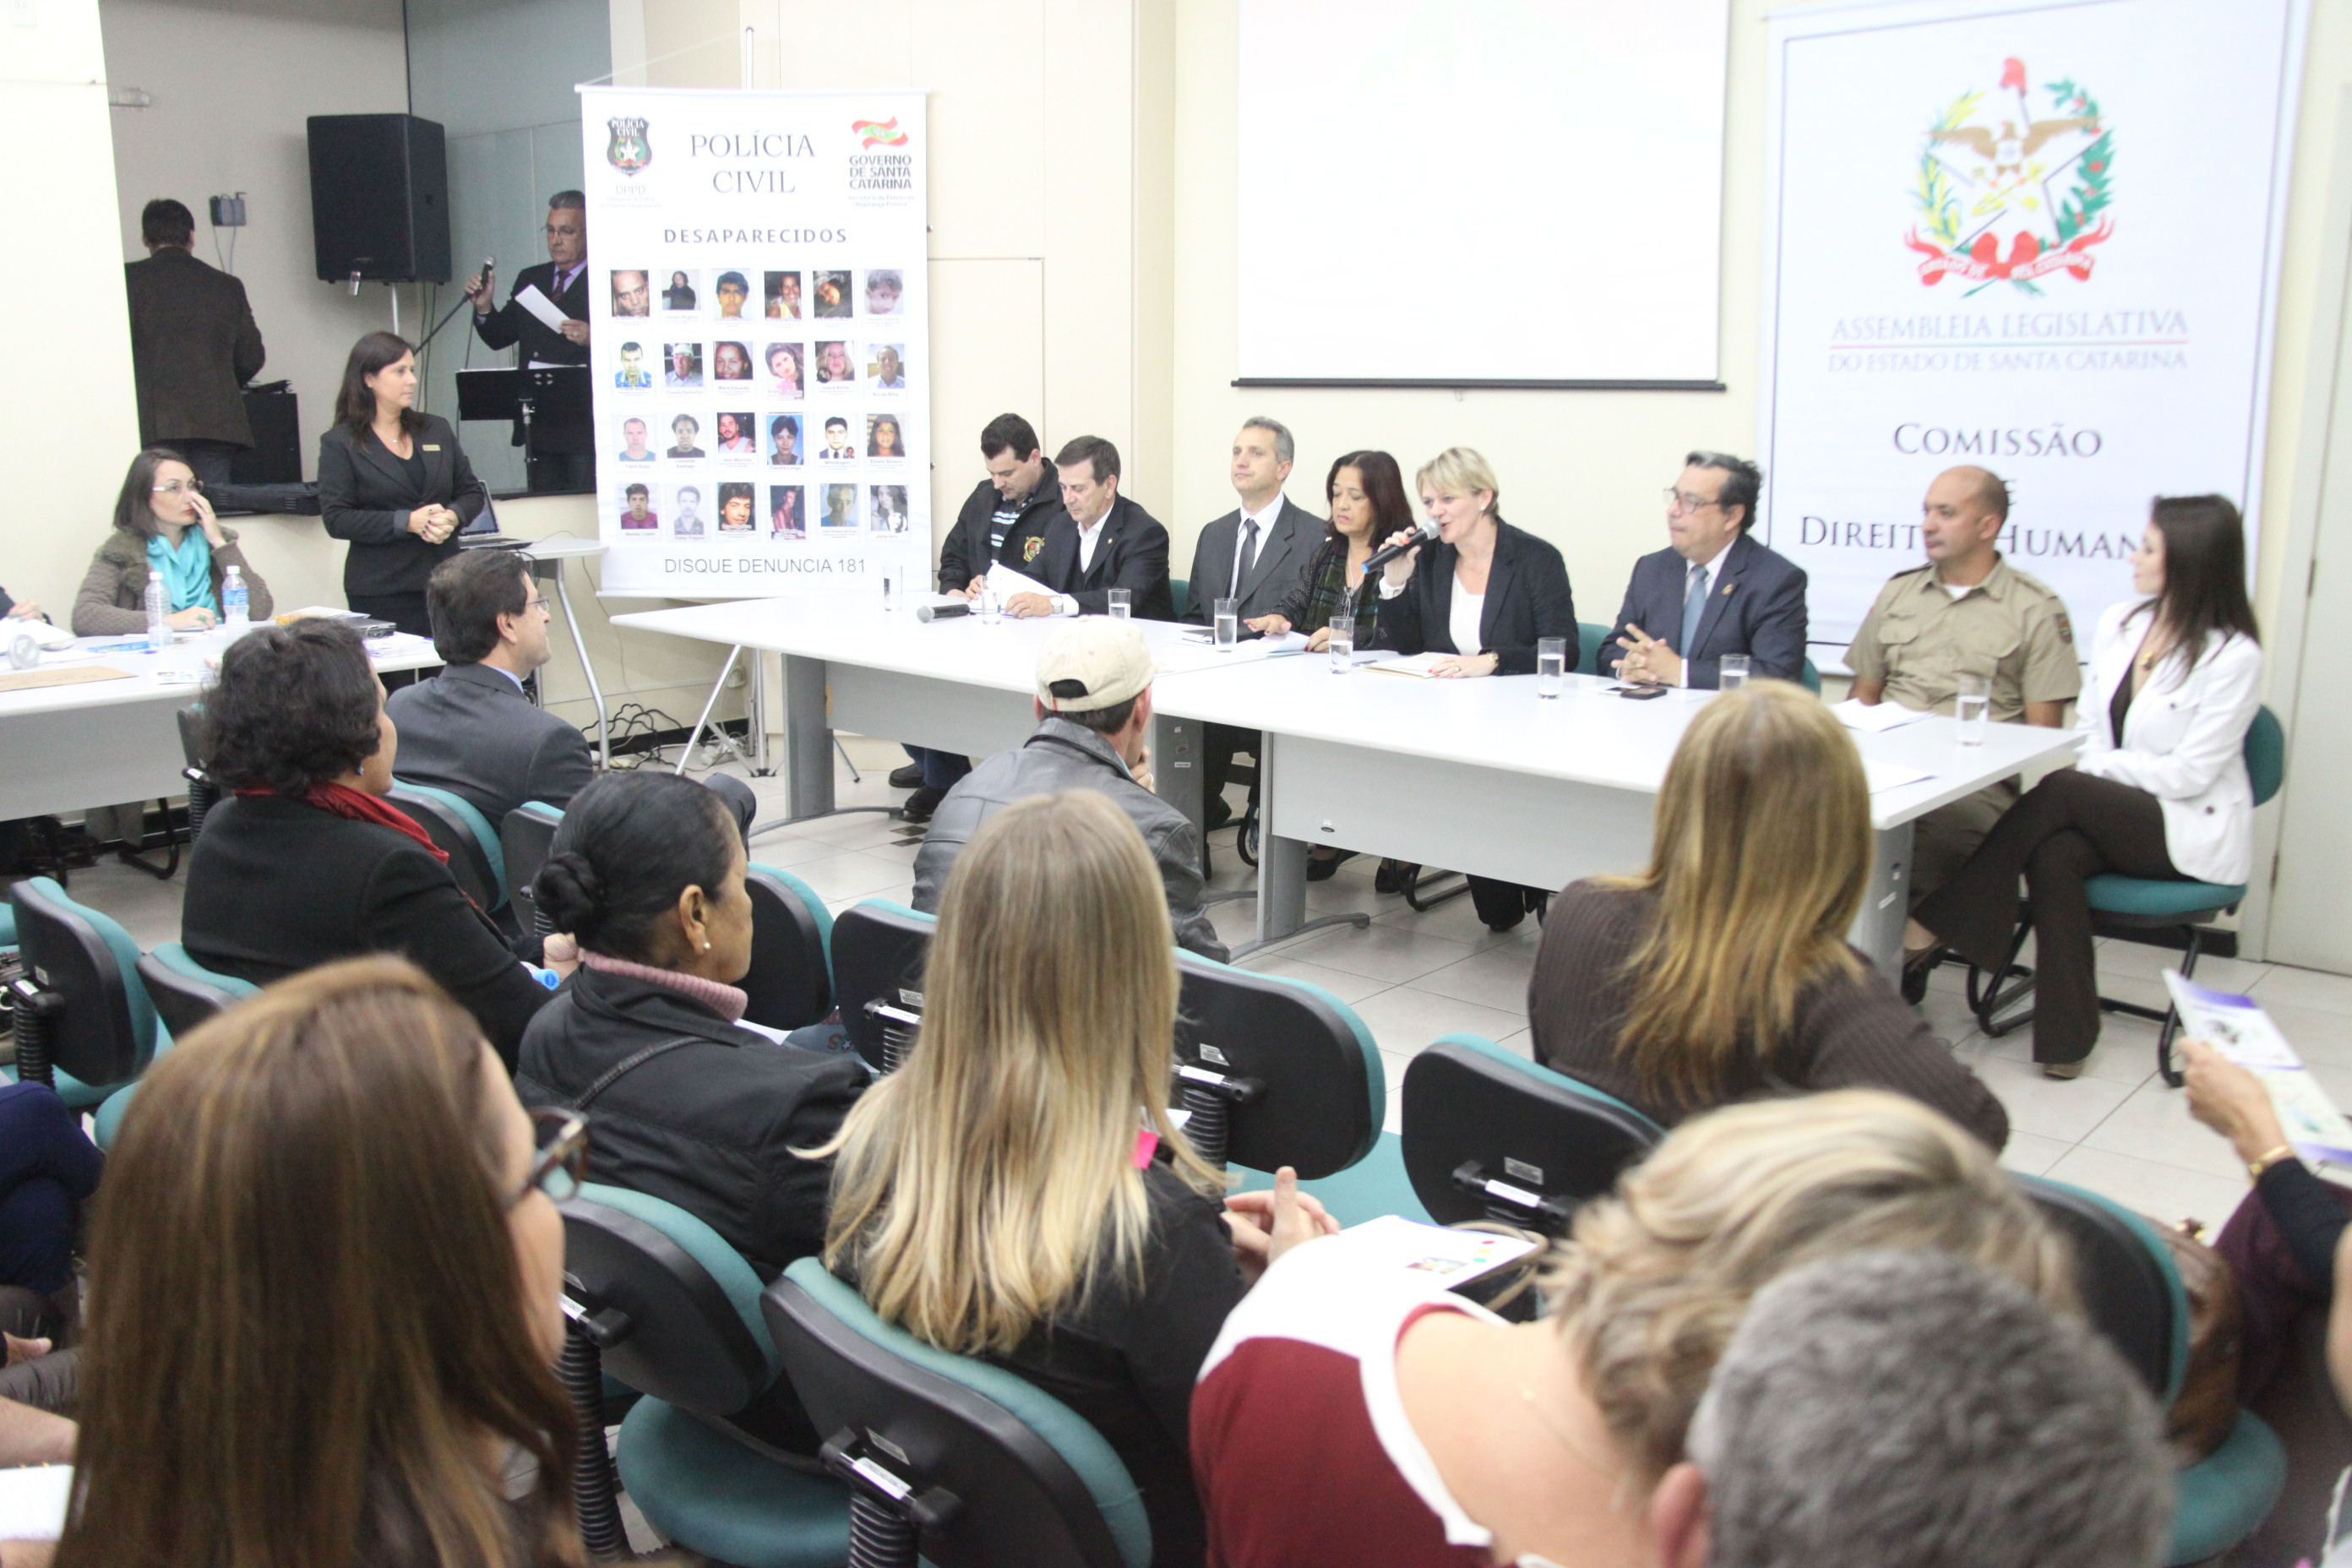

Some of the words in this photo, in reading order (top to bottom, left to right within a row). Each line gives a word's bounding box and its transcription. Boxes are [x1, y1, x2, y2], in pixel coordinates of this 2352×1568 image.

[691, 129, 815, 157] POLÍCIA
[849, 155, 912, 166] GOVERNO
[850, 166, 866, 177] DE
[870, 166, 912, 177] SANTA
[616, 185, 645, 195] DPPD
[712, 171, 796, 193] CIVIL
[849, 178, 912, 190] CATARINA
[664, 227, 848, 243] DESAPARECIDOS
[1832, 315, 1994, 341] ASSEMBLEIA
[2001, 310, 2189, 338] LEGISLATIVA
[1828, 354, 1862, 373] DO
[1866, 352, 1949, 372] ESTADO
[1956, 352, 1983, 371] DE
[1988, 351, 2059, 372] SANTA
[2064, 349, 2188, 371] CATARINA
[1892, 422, 2103, 458] COMISSÃO
[1799, 515, 1922, 550] DIREIT
[1995, 525, 2138, 560] HUMAN
[665, 558, 733, 575] DISQUE
[738, 558, 833, 574] DENUNCIA
[838, 558, 865, 574] 181
